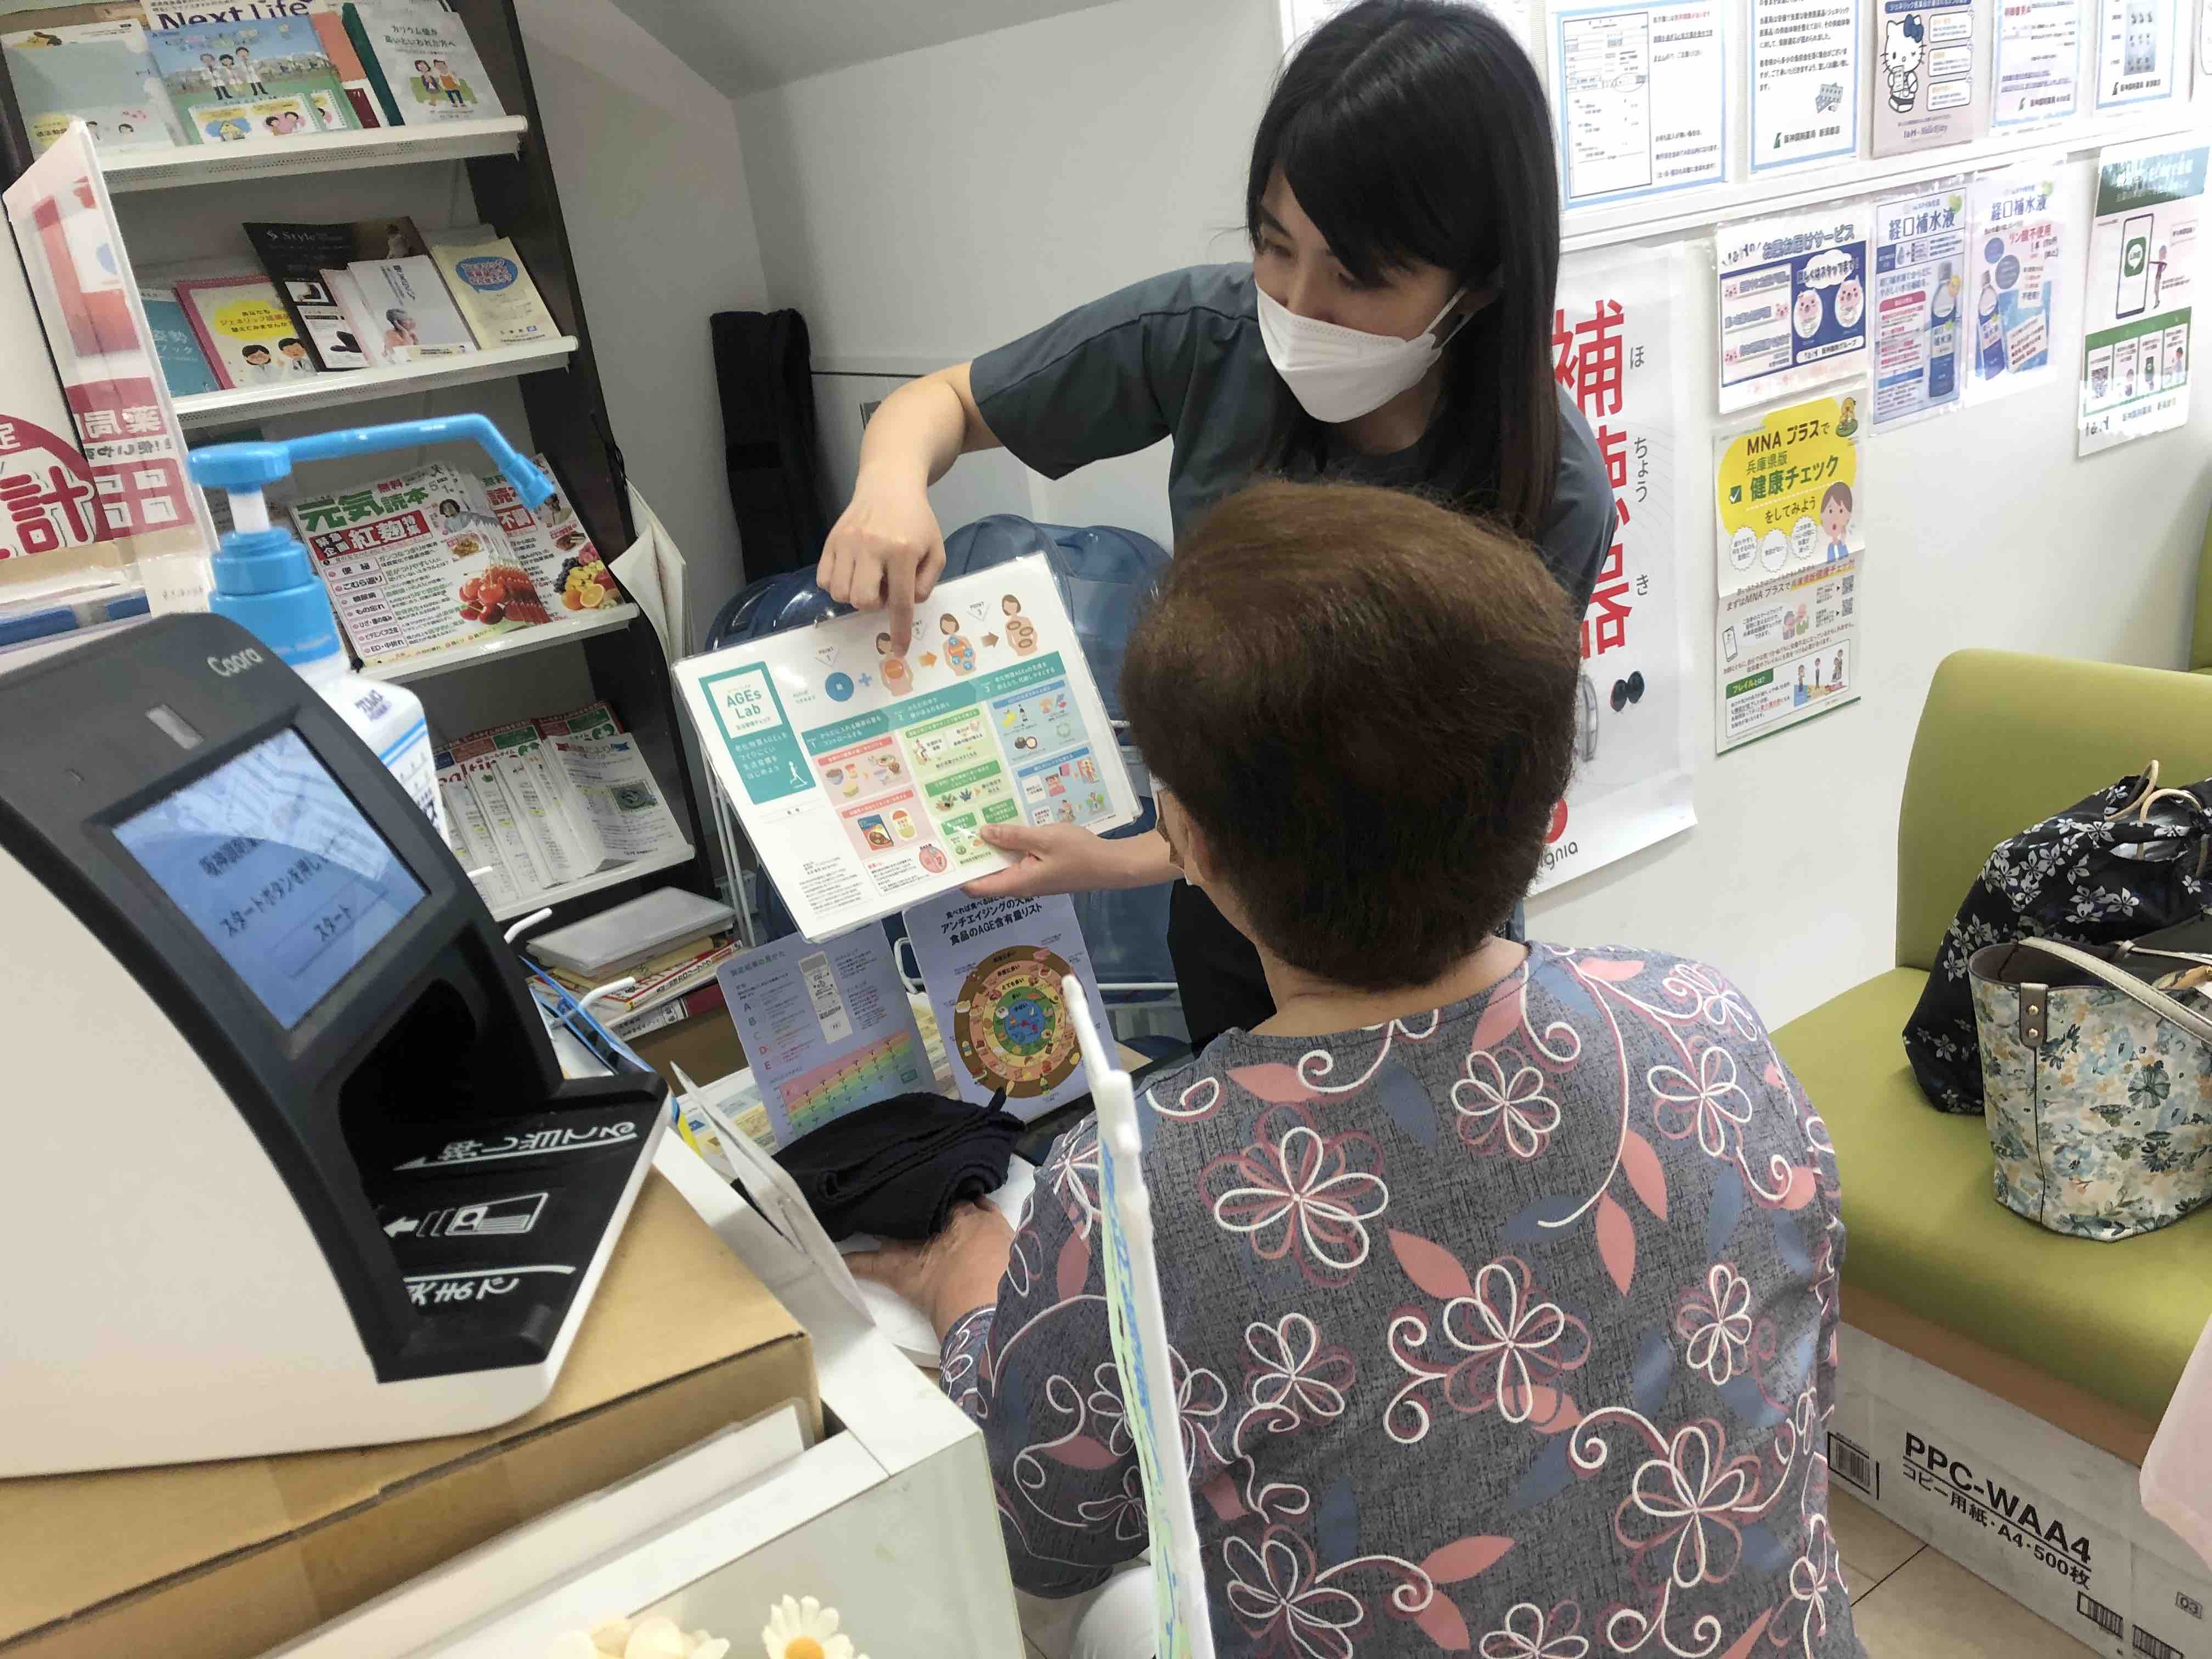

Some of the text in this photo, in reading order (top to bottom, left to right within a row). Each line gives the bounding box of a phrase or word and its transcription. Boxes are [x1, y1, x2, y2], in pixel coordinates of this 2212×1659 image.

[157, 5, 244, 30] Next
[1991, 194, 2047, 222] 経口補水液
[1889, 207, 1956, 241] 経口補水液
[282, 230, 317, 242] Style
[1630, 346, 1645, 370] ほ
[1747, 419, 1830, 456] MNA プラスで
[1634, 437, 1648, 503] ちょう
[1746, 450, 1788, 475] 兵庫県版
[1750, 455, 1839, 501] 健康チェック
[1764, 496, 1816, 524] をしてみよう
[343, 575, 382, 590] こむら返り
[1635, 573, 1650, 596] き
[356, 603, 384, 615] もの忘れ
[370, 639, 405, 652] ED・中折れ
[726, 689, 763, 708] AGEs
[735, 703, 761, 719] Lab
[1543, 840, 1579, 871] gnia
[313, 902, 356, 941] スタート
[949, 902, 1043, 946] 食品のAGE含有量リスト
[1002, 977, 1025, 990] とても多い
[744, 1002, 752, 1012] A
[748, 1017, 757, 1027] B
[753, 1031, 763, 1041] C
[759, 1045, 768, 1055] D
[764, 1060, 773, 1071] E
[1905, 1430, 2091, 1564] PPC-WAA4
[2180, 1595, 2201, 1616] 03
